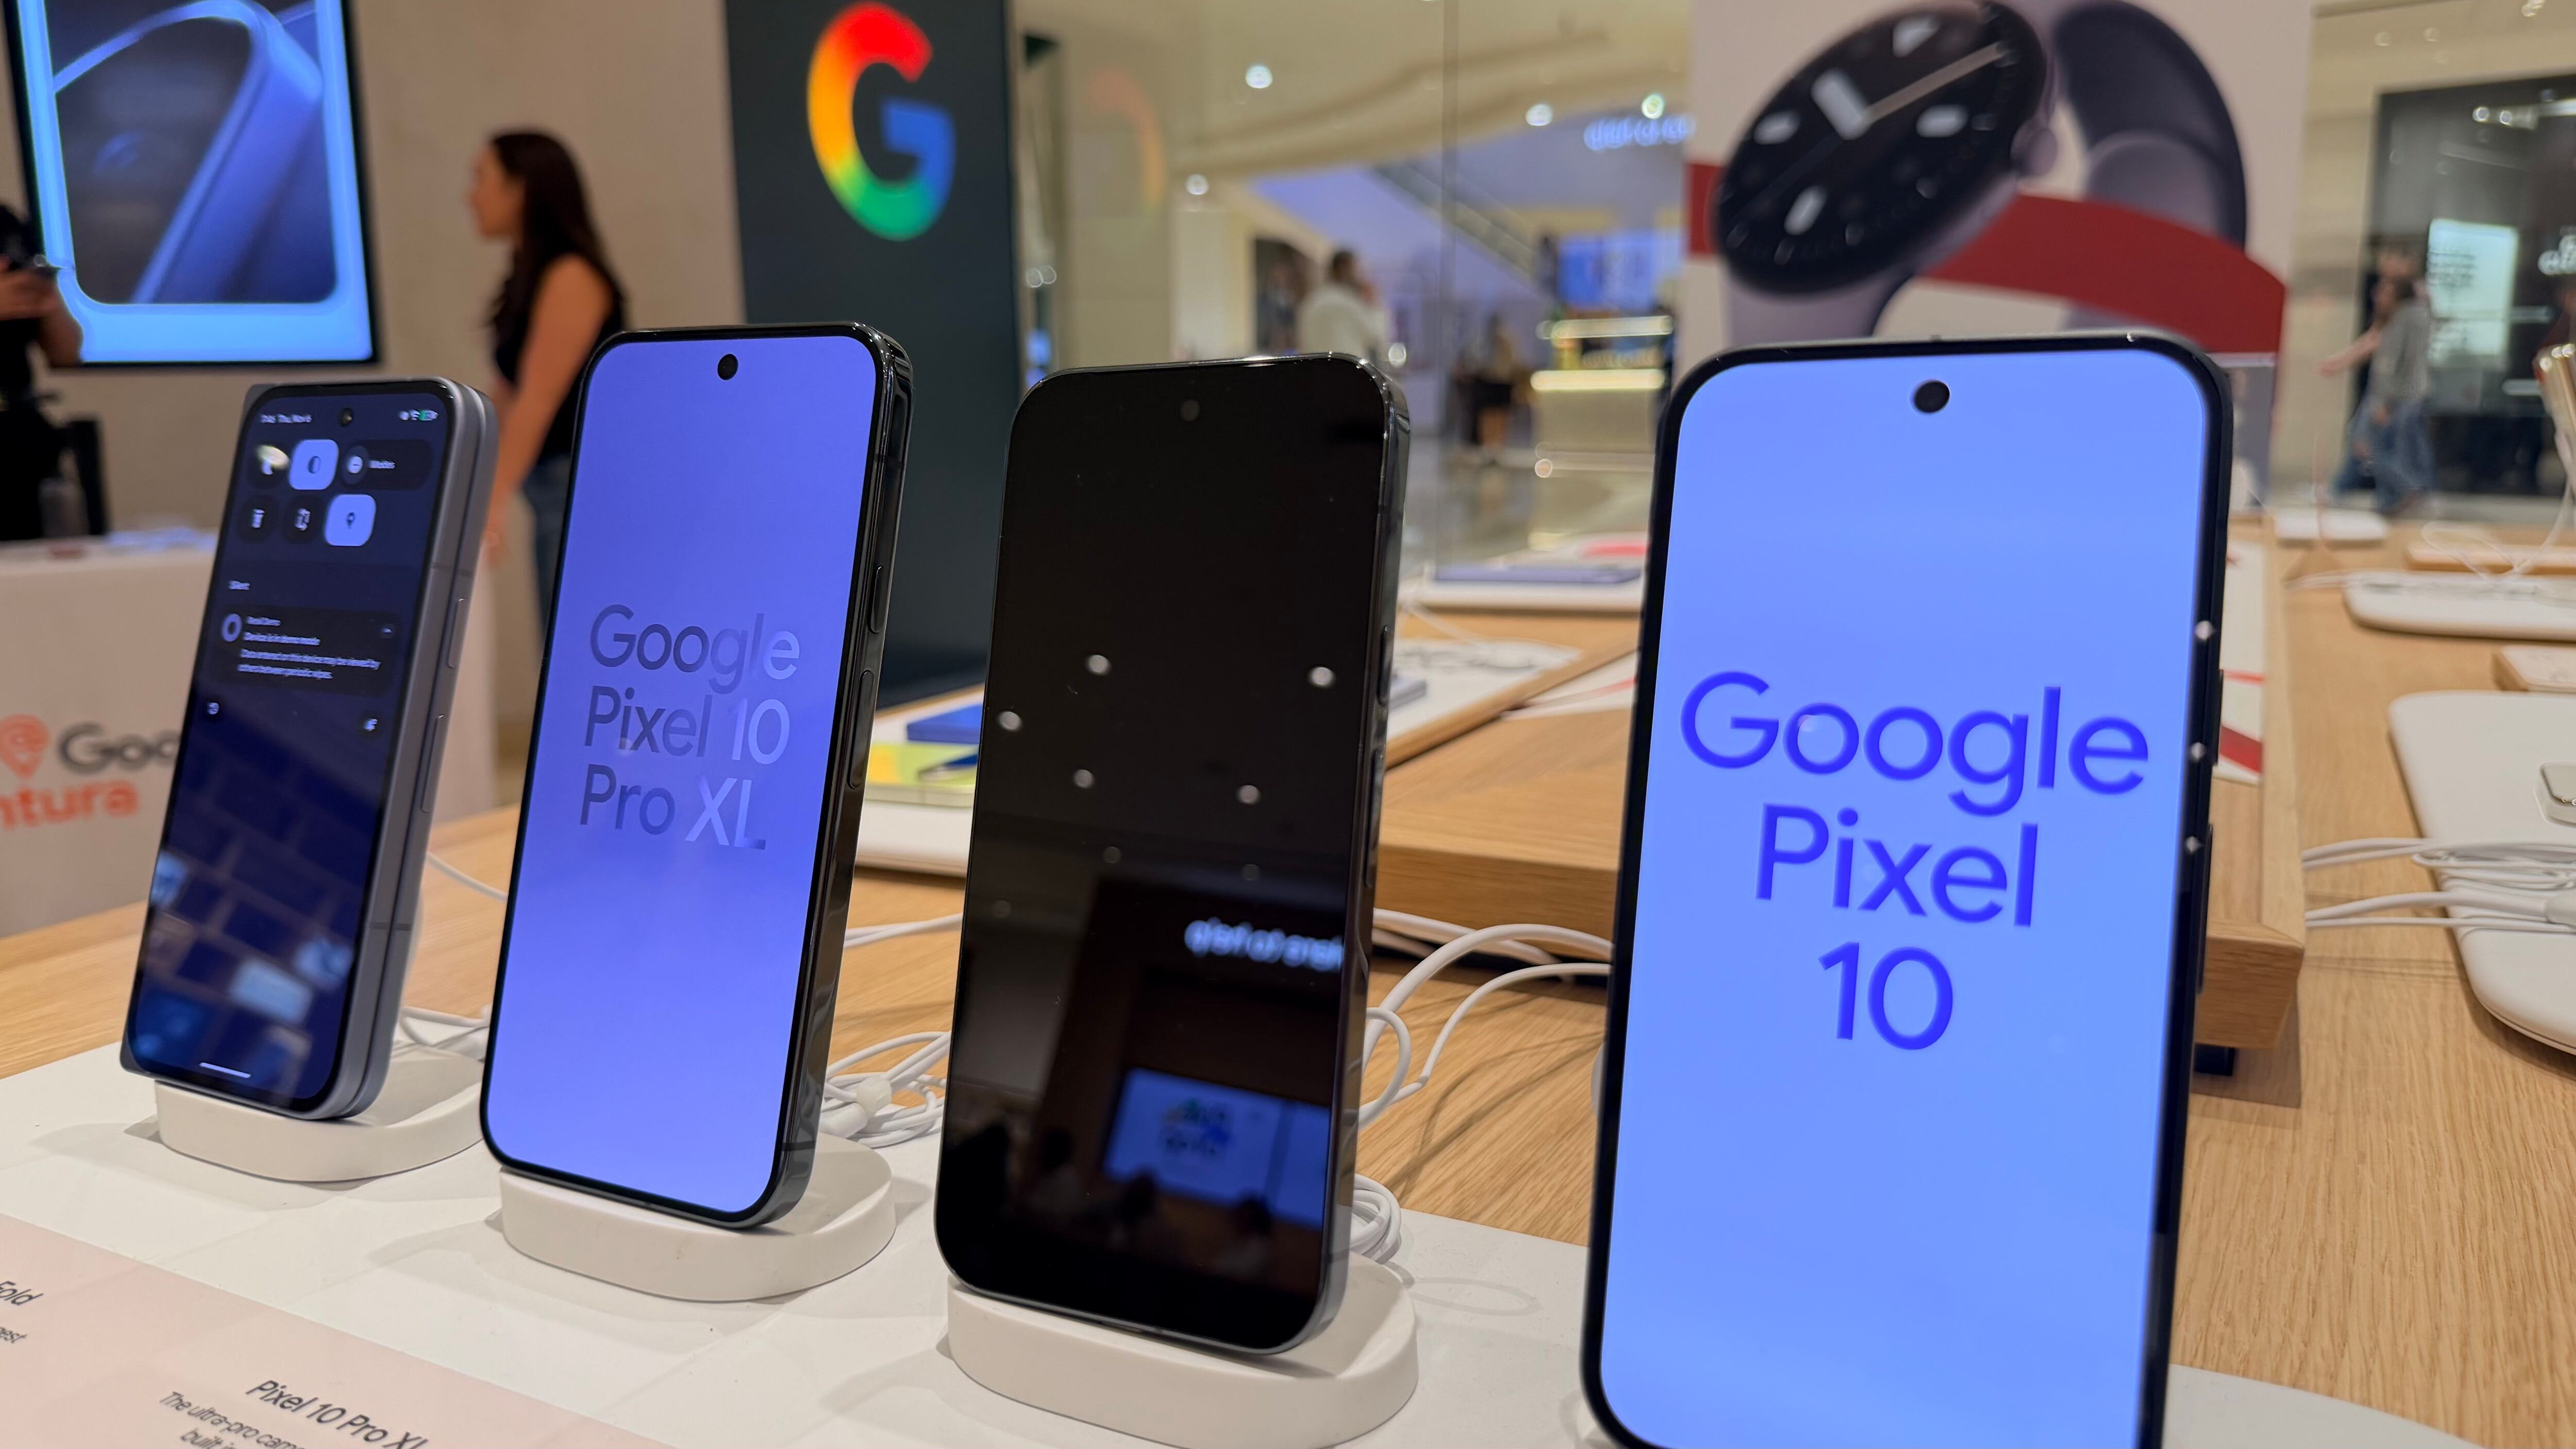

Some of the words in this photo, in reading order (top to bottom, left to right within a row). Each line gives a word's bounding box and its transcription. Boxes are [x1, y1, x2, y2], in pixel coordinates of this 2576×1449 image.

[807, 3, 956, 241] G
[590, 604, 800, 694] Google
[585, 686, 713, 757] Pixel
[728, 698, 790, 764] 10
[1680, 671, 2149, 817] Google
[580, 763, 675, 835] Pro
[685, 775, 767, 850] XL
[1756, 803, 2038, 927] Pixel
[1818, 941, 1953, 1050] 10
[159, 1391, 192, 1411] The
[187, 1406, 260, 1438] ultra-pro
[245, 1380, 318, 1412] Pixel
[306, 1403, 347, 1424] 10
[335, 1413, 389, 1442] Pro
